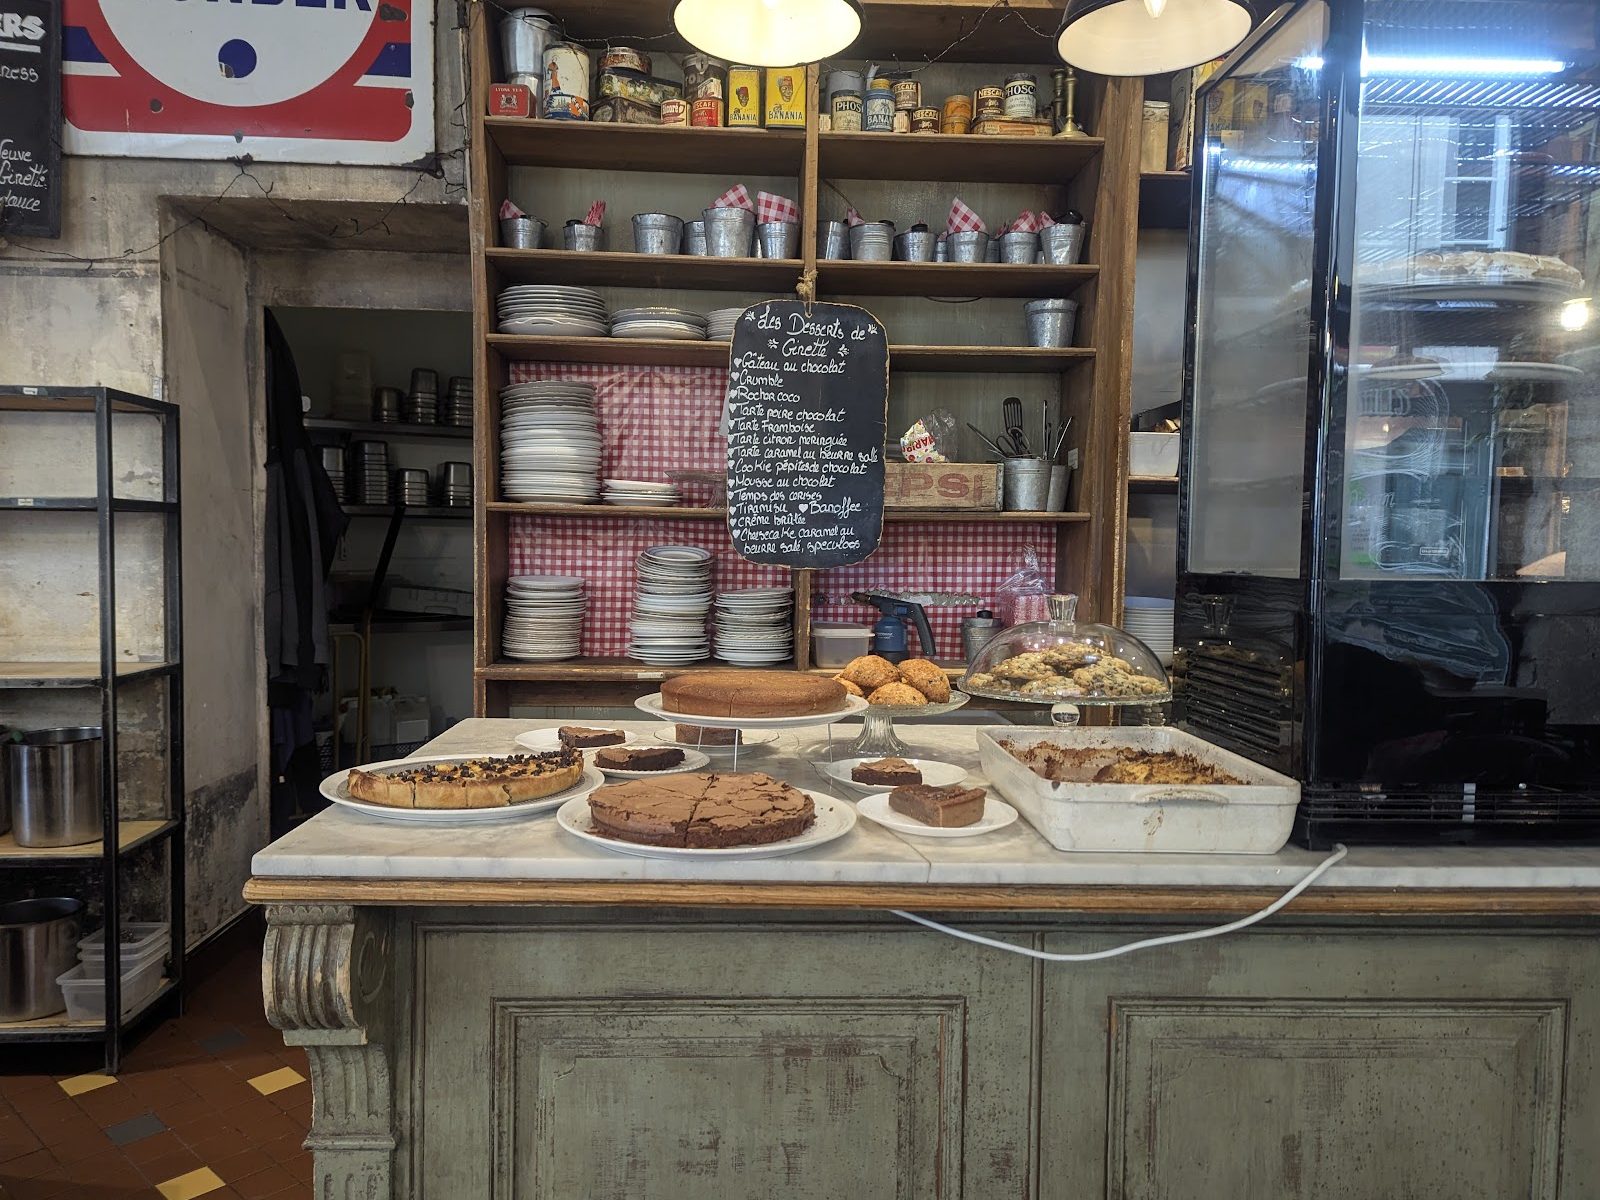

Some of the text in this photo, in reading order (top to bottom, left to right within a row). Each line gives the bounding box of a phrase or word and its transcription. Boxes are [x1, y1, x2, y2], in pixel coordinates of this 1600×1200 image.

[0, 12, 46, 40] RS
[0, 65, 39, 83] ness
[1003, 85, 1036, 97] HOSC
[768, 110, 803, 120] BANANIA
[836, 101, 864, 113] PHOS
[757, 305, 866, 341] Les Desserts de
[781, 337, 830, 358] Ginette
[741, 351, 846, 374] Gâteau au chocolat
[739, 368, 784, 388] Crumble
[776, 391, 800, 403] coco
[736, 400, 846, 423] Tarte poire chocolat
[734, 416, 760, 432] Tarte
[733, 431, 848, 452] Tarte citron meringuée
[733, 445, 761, 458] Tarte
[764, 445, 802, 459] caramel
[802, 449, 816, 460] au
[735, 457, 773, 473] Cookie
[821, 462, 868, 475] chocolat
[735, 474, 837, 489] Mousse au chocolat
[733, 487, 768, 503] Temps
[769, 490, 786, 501] des
[736, 501, 788, 514] Tiramisu
[808, 496, 862, 520] Banoffee
[798, 525, 839, 538] caramel
[839, 526, 855, 537] au
[806, 536, 861, 555] speculoos
